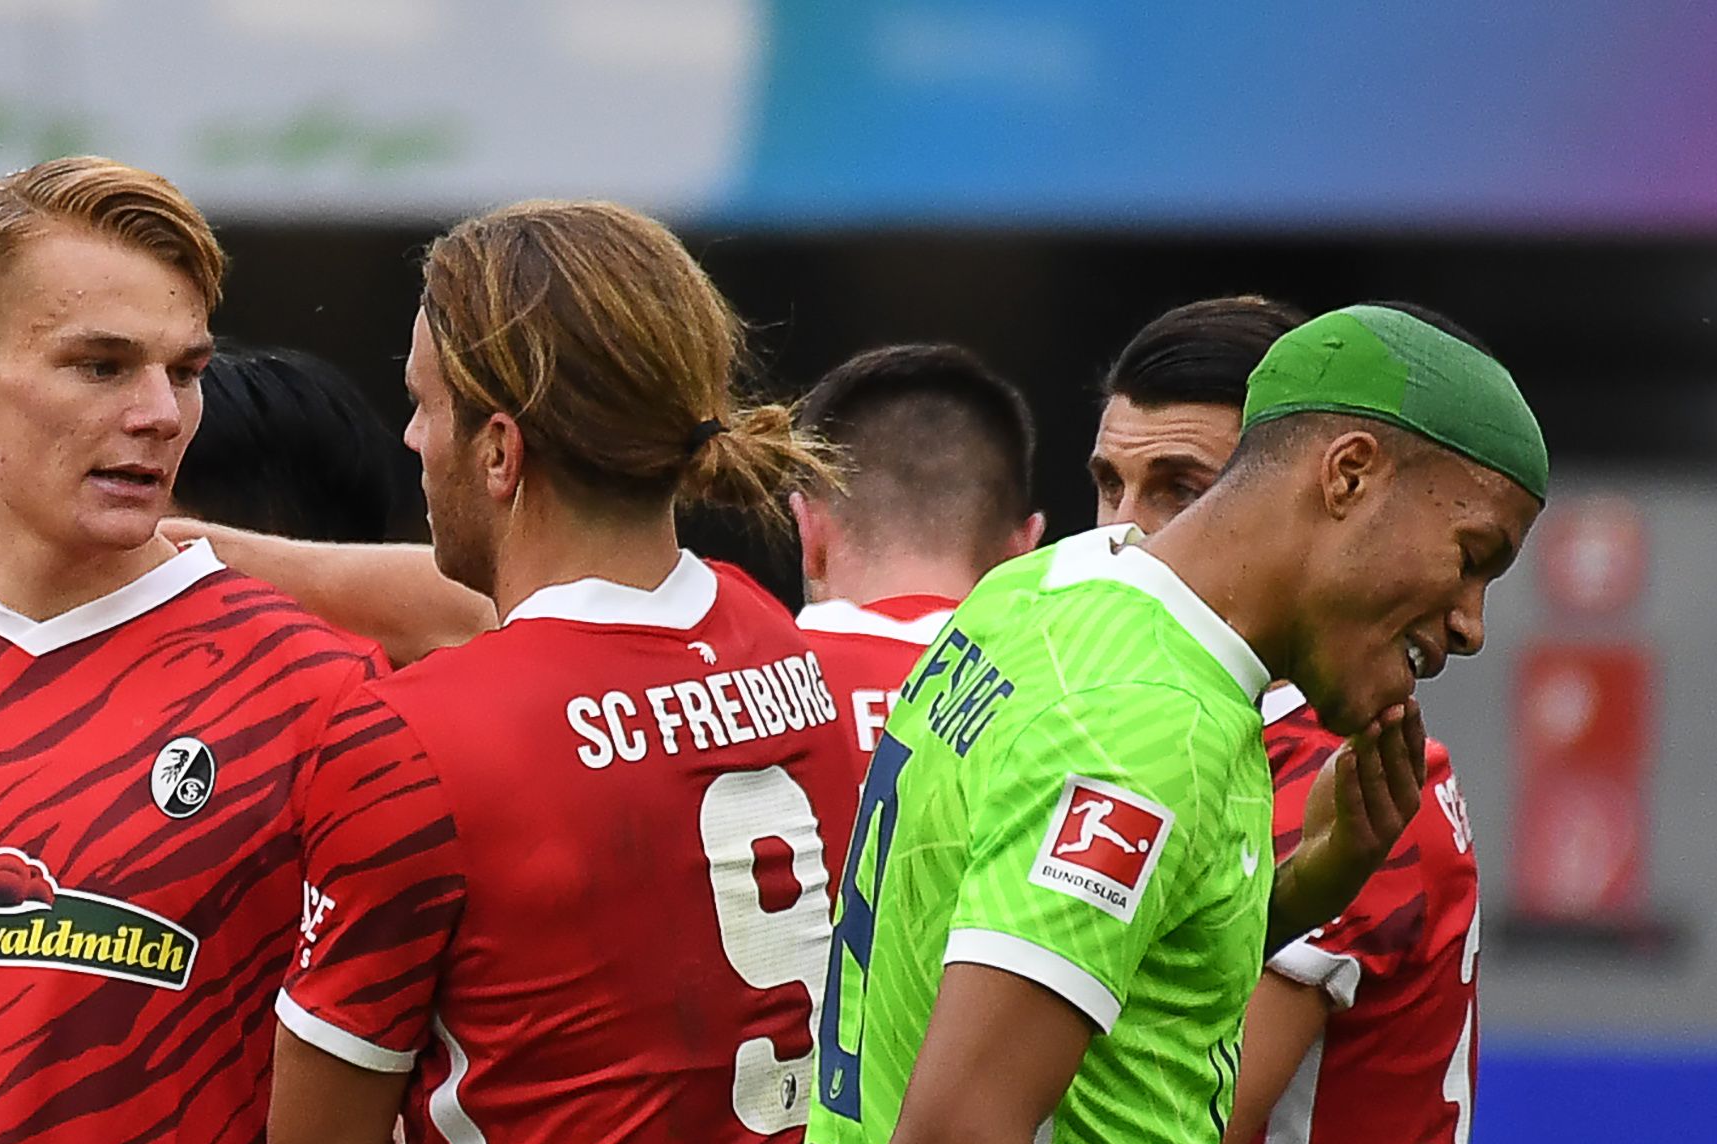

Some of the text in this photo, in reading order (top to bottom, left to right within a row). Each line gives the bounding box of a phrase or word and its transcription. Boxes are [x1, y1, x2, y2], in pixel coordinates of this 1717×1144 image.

[566, 650, 838, 769] SC FREIBURG
[1042, 865, 1128, 909] BUNDESLIGA
[699, 764, 835, 1136] 9
